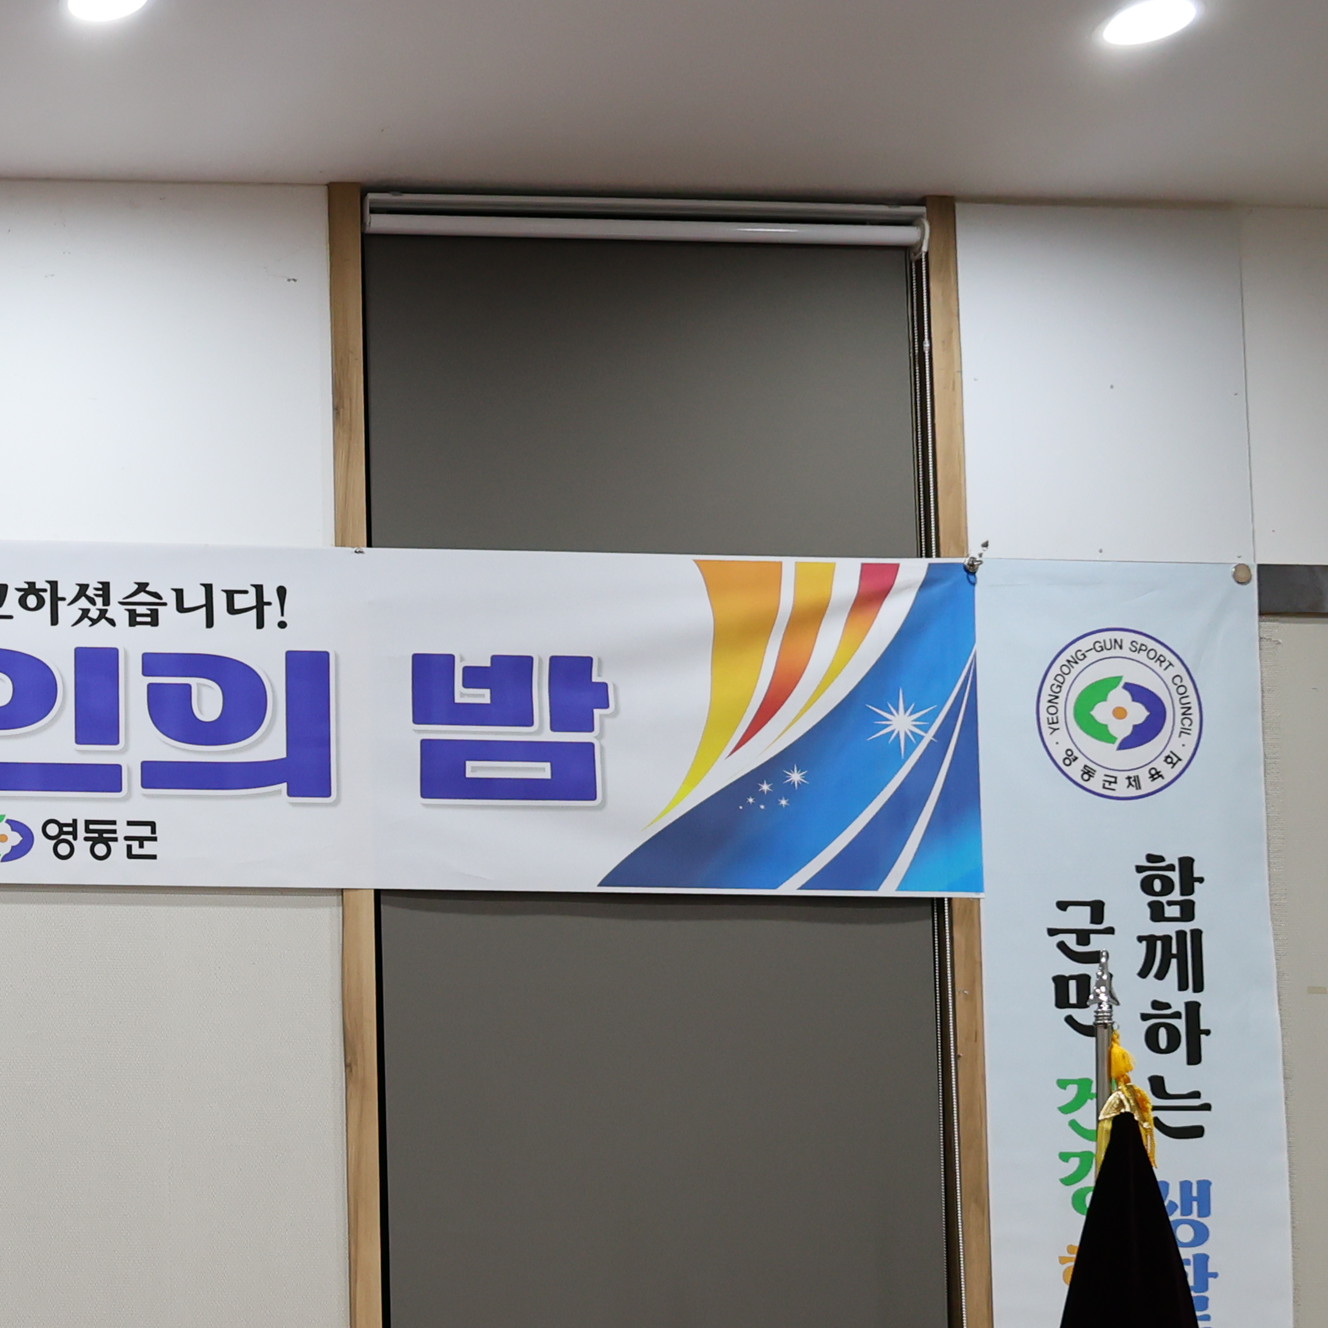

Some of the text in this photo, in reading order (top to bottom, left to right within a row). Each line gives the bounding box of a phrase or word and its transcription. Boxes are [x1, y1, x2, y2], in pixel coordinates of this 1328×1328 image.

[411, 653, 610, 801] 밤
[1046, 638, 1194, 740] YEONGDONG-GUN SPORT COUNCIL
[1062, 748, 1183, 792] 영동군체육회
[41, 818, 158, 861] 영동군
[1134, 853, 1212, 1140] 함께하는
